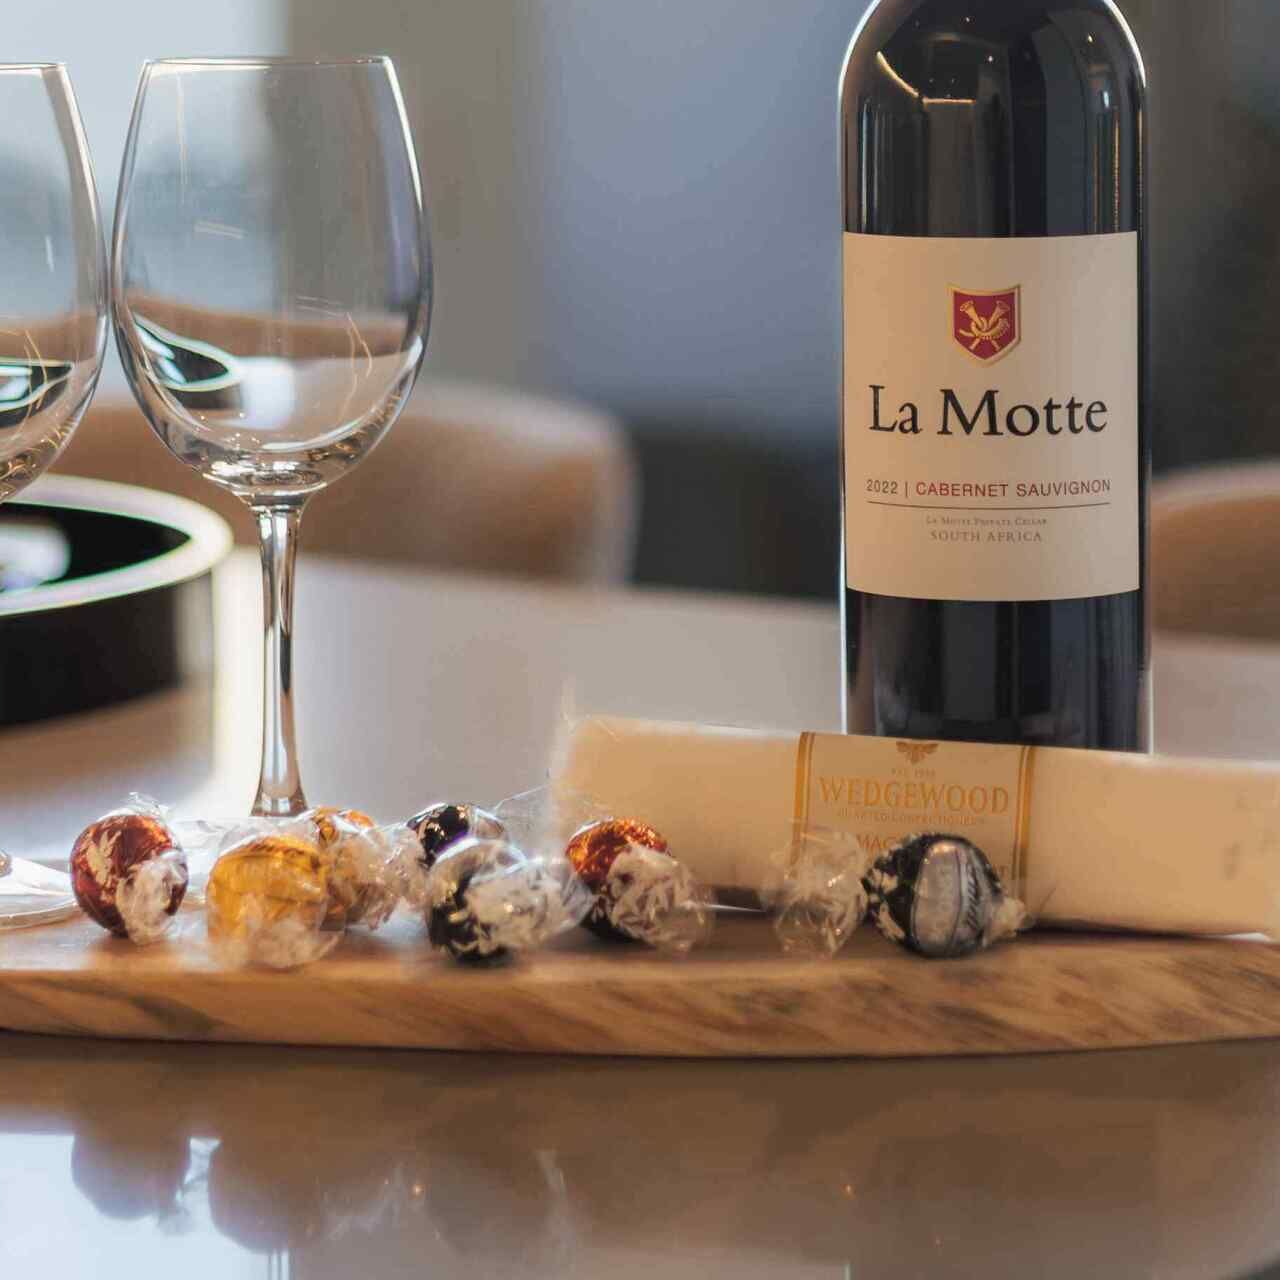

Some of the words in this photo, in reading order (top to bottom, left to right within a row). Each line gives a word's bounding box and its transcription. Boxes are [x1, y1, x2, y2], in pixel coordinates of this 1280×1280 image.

[868, 384, 923, 435] La
[936, 388, 1108, 437] Motte
[866, 478, 898, 495] 2022
[915, 480, 1009, 497] CABERNET
[1016, 478, 1111, 498] SAUVIGNON
[930, 530, 980, 542] SOUTH
[987, 530, 1042, 543] AFRICA
[818, 776, 1010, 814] WEDGEWOOD
